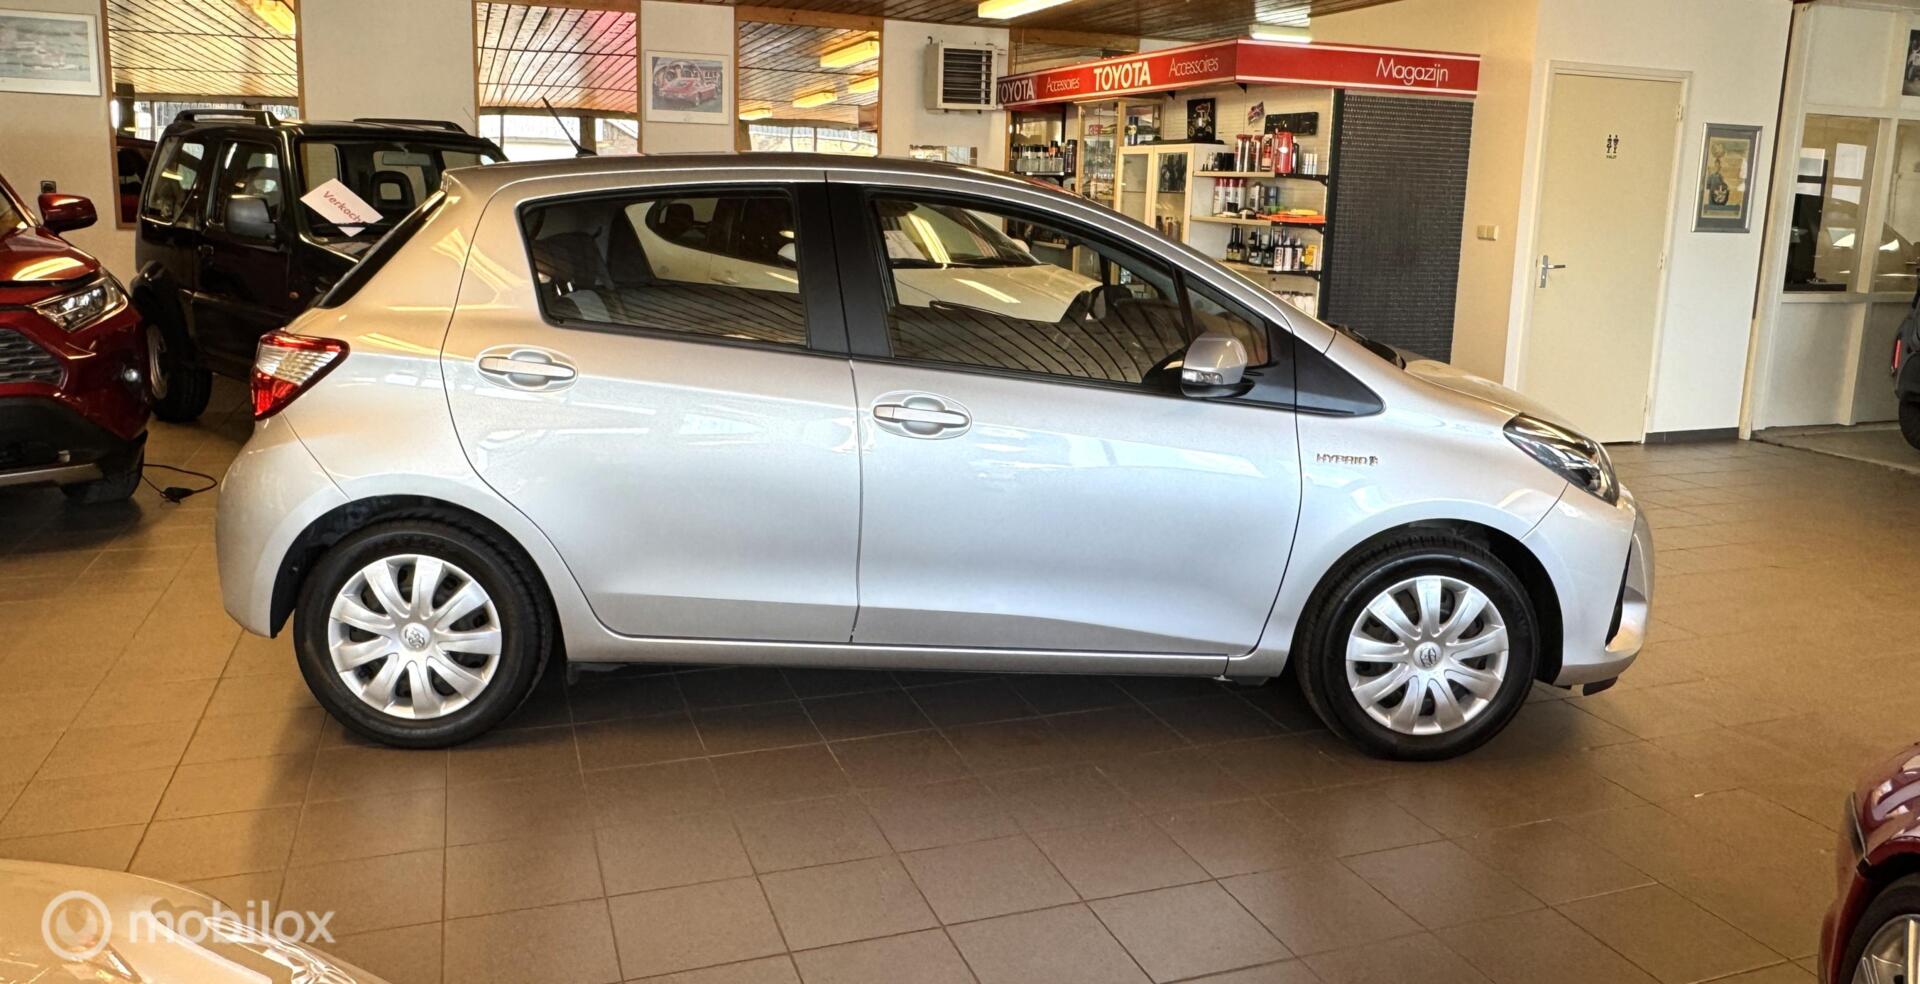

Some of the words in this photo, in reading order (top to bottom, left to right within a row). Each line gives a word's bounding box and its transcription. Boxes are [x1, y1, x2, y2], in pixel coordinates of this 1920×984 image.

[998, 78, 1035, 103] TOYOTA
[1045, 76, 1080, 94] Accessoires
[1093, 61, 1151, 91] TOYOTA
[1168, 55, 1219, 78] Accessoires
[1376, 57, 1449, 88] Magazijn
[323, 190, 363, 222] Verkoch
[1316, 453, 1368, 465] HYBRID
